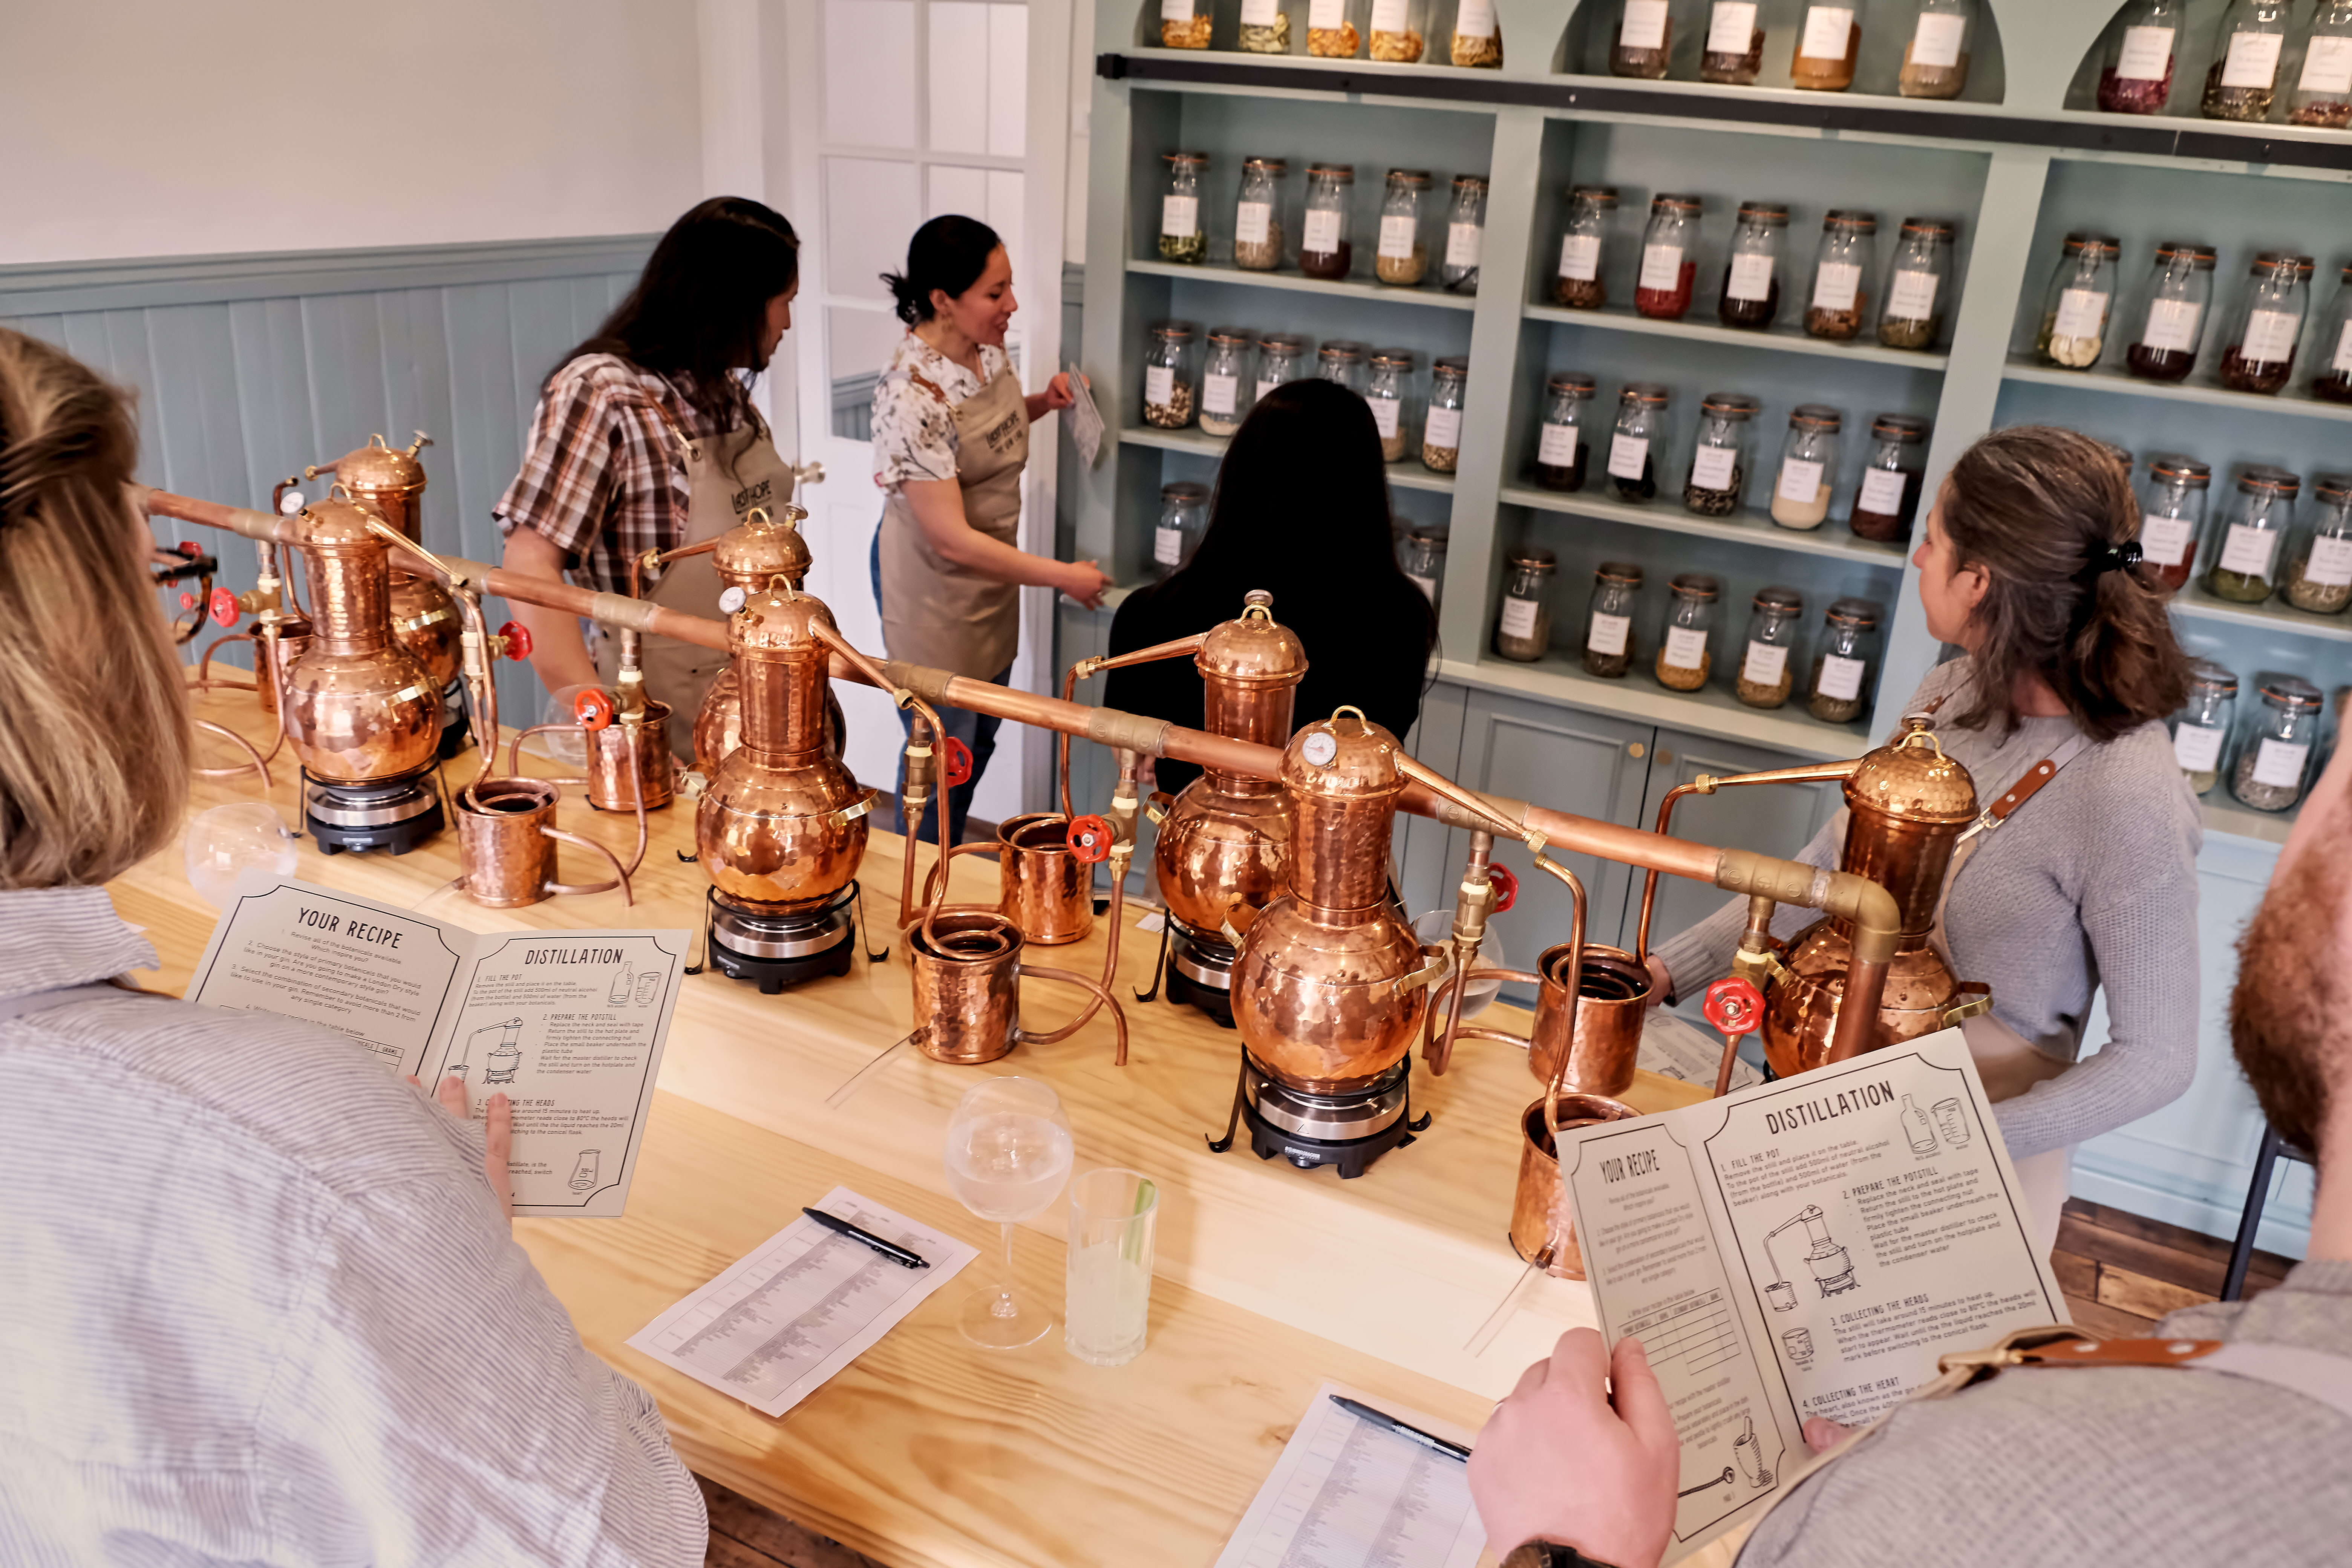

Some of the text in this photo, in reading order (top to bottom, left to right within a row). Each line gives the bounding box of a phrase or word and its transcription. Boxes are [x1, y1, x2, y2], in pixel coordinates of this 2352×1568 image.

[298, 907, 403, 949] YOUR RECIPE
[525, 949, 623, 965] DISTILLATION
[345, 1027, 365, 1037] below
[1766, 1080, 1895, 1135] DISTILLATION
[1599, 1149, 1660, 1184] YOUR RECIPE
[1731, 1158, 1748, 1169] FILL
[1749, 1153, 1764, 1164] THE
[1765, 1148, 1779, 1159] POT
[1842, 1166, 1938, 1199] 2. PREPARE THE POTSTILL
[1830, 1293, 1929, 1326] 3. COLLECTING THE HEADS
[1812, 1387, 1856, 1406] COLLECTING
[1858, 1383, 1873, 1394] THE
[1876, 1376, 1899, 1389] HEART
